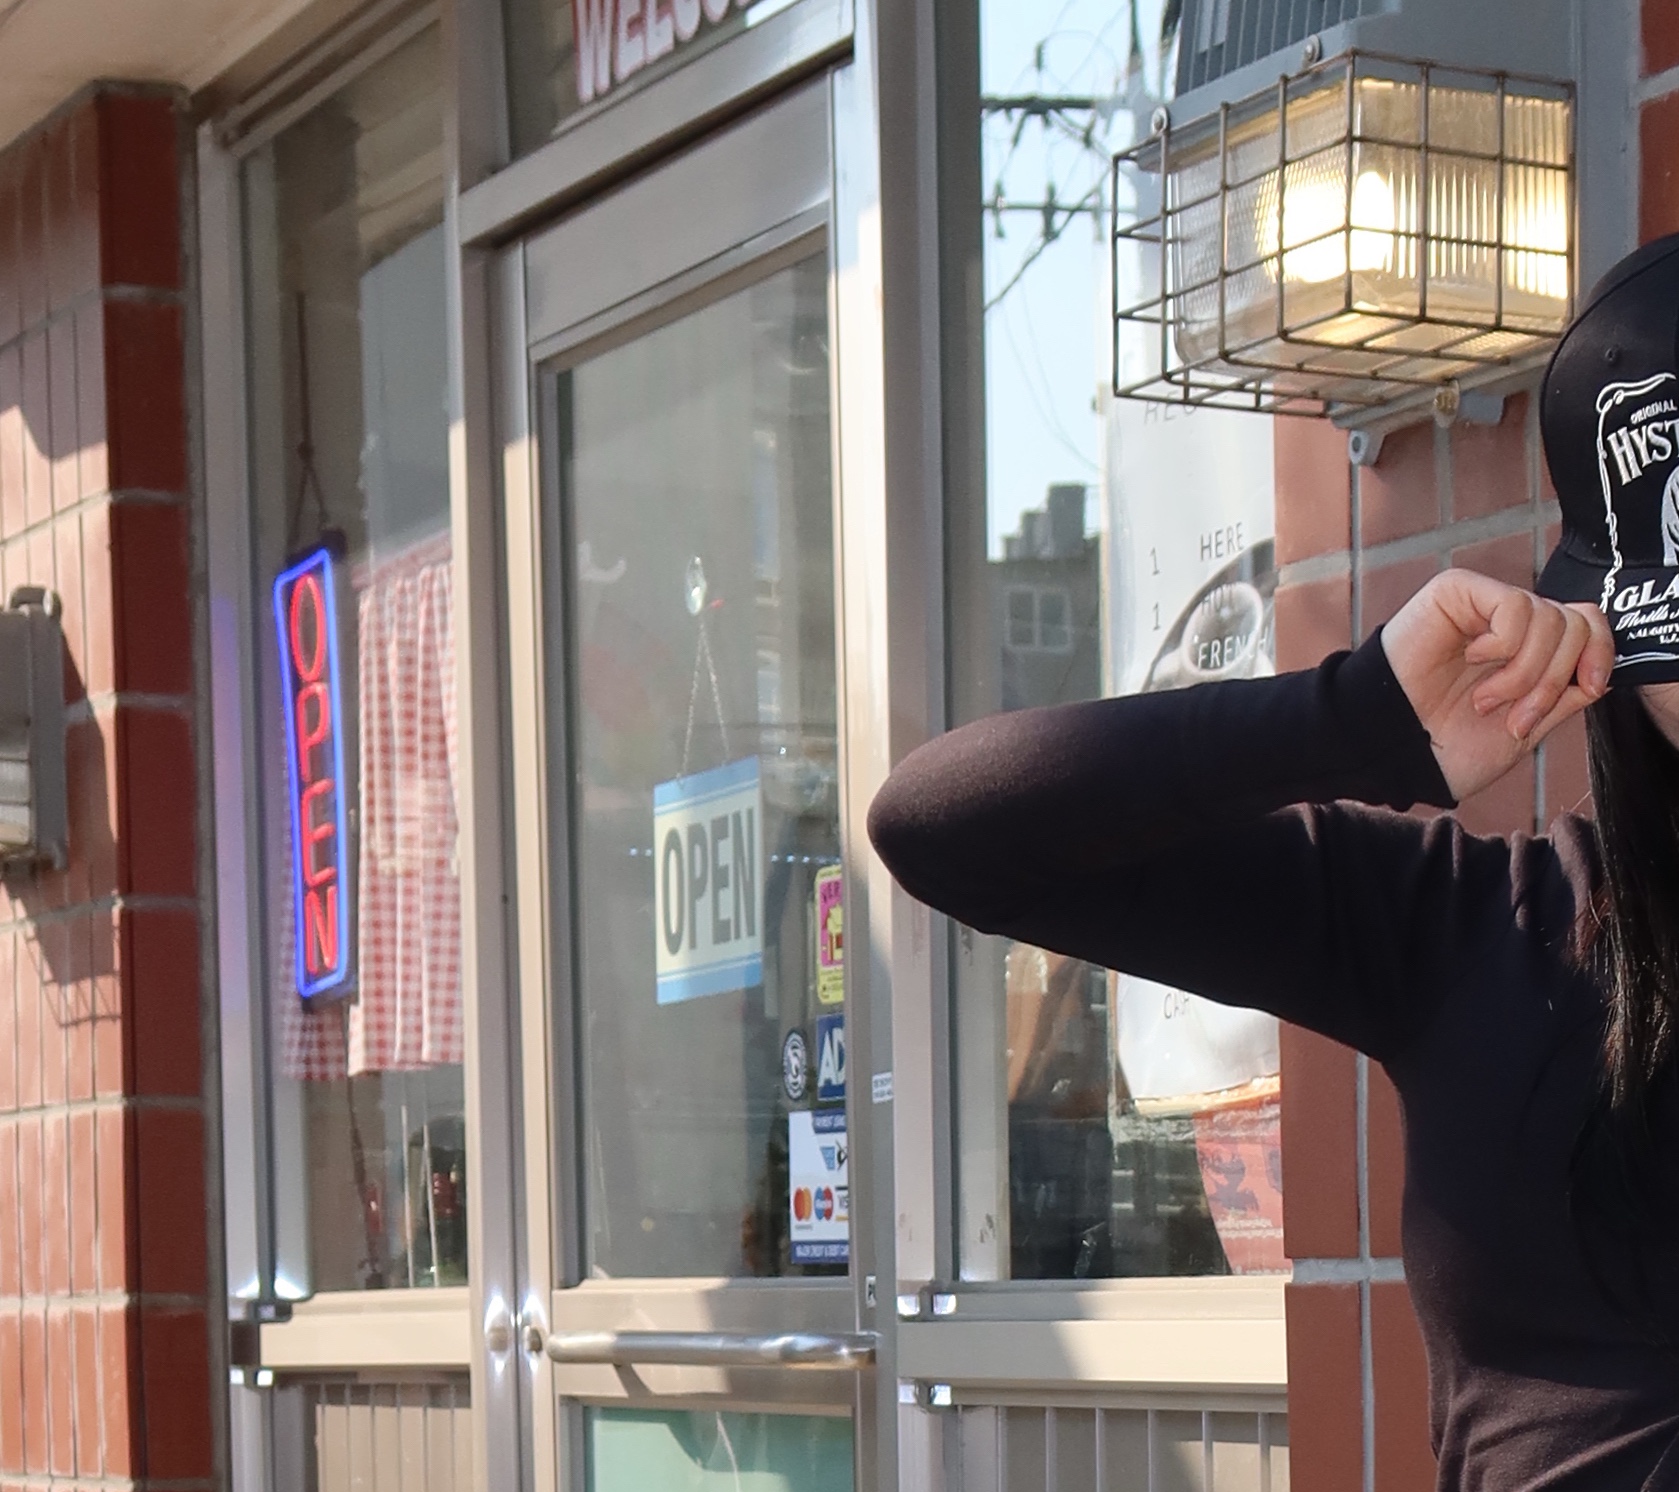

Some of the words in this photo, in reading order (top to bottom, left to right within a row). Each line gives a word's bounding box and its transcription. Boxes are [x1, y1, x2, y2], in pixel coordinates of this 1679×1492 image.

[1630, 399, 1677, 424] ORIGINAL
[1200, 522, 1245, 561] HERE
[1615, 603, 1668, 631] Thrills
[290, 573, 338, 976] OPEN
[661, 807, 756, 957] OPEN
